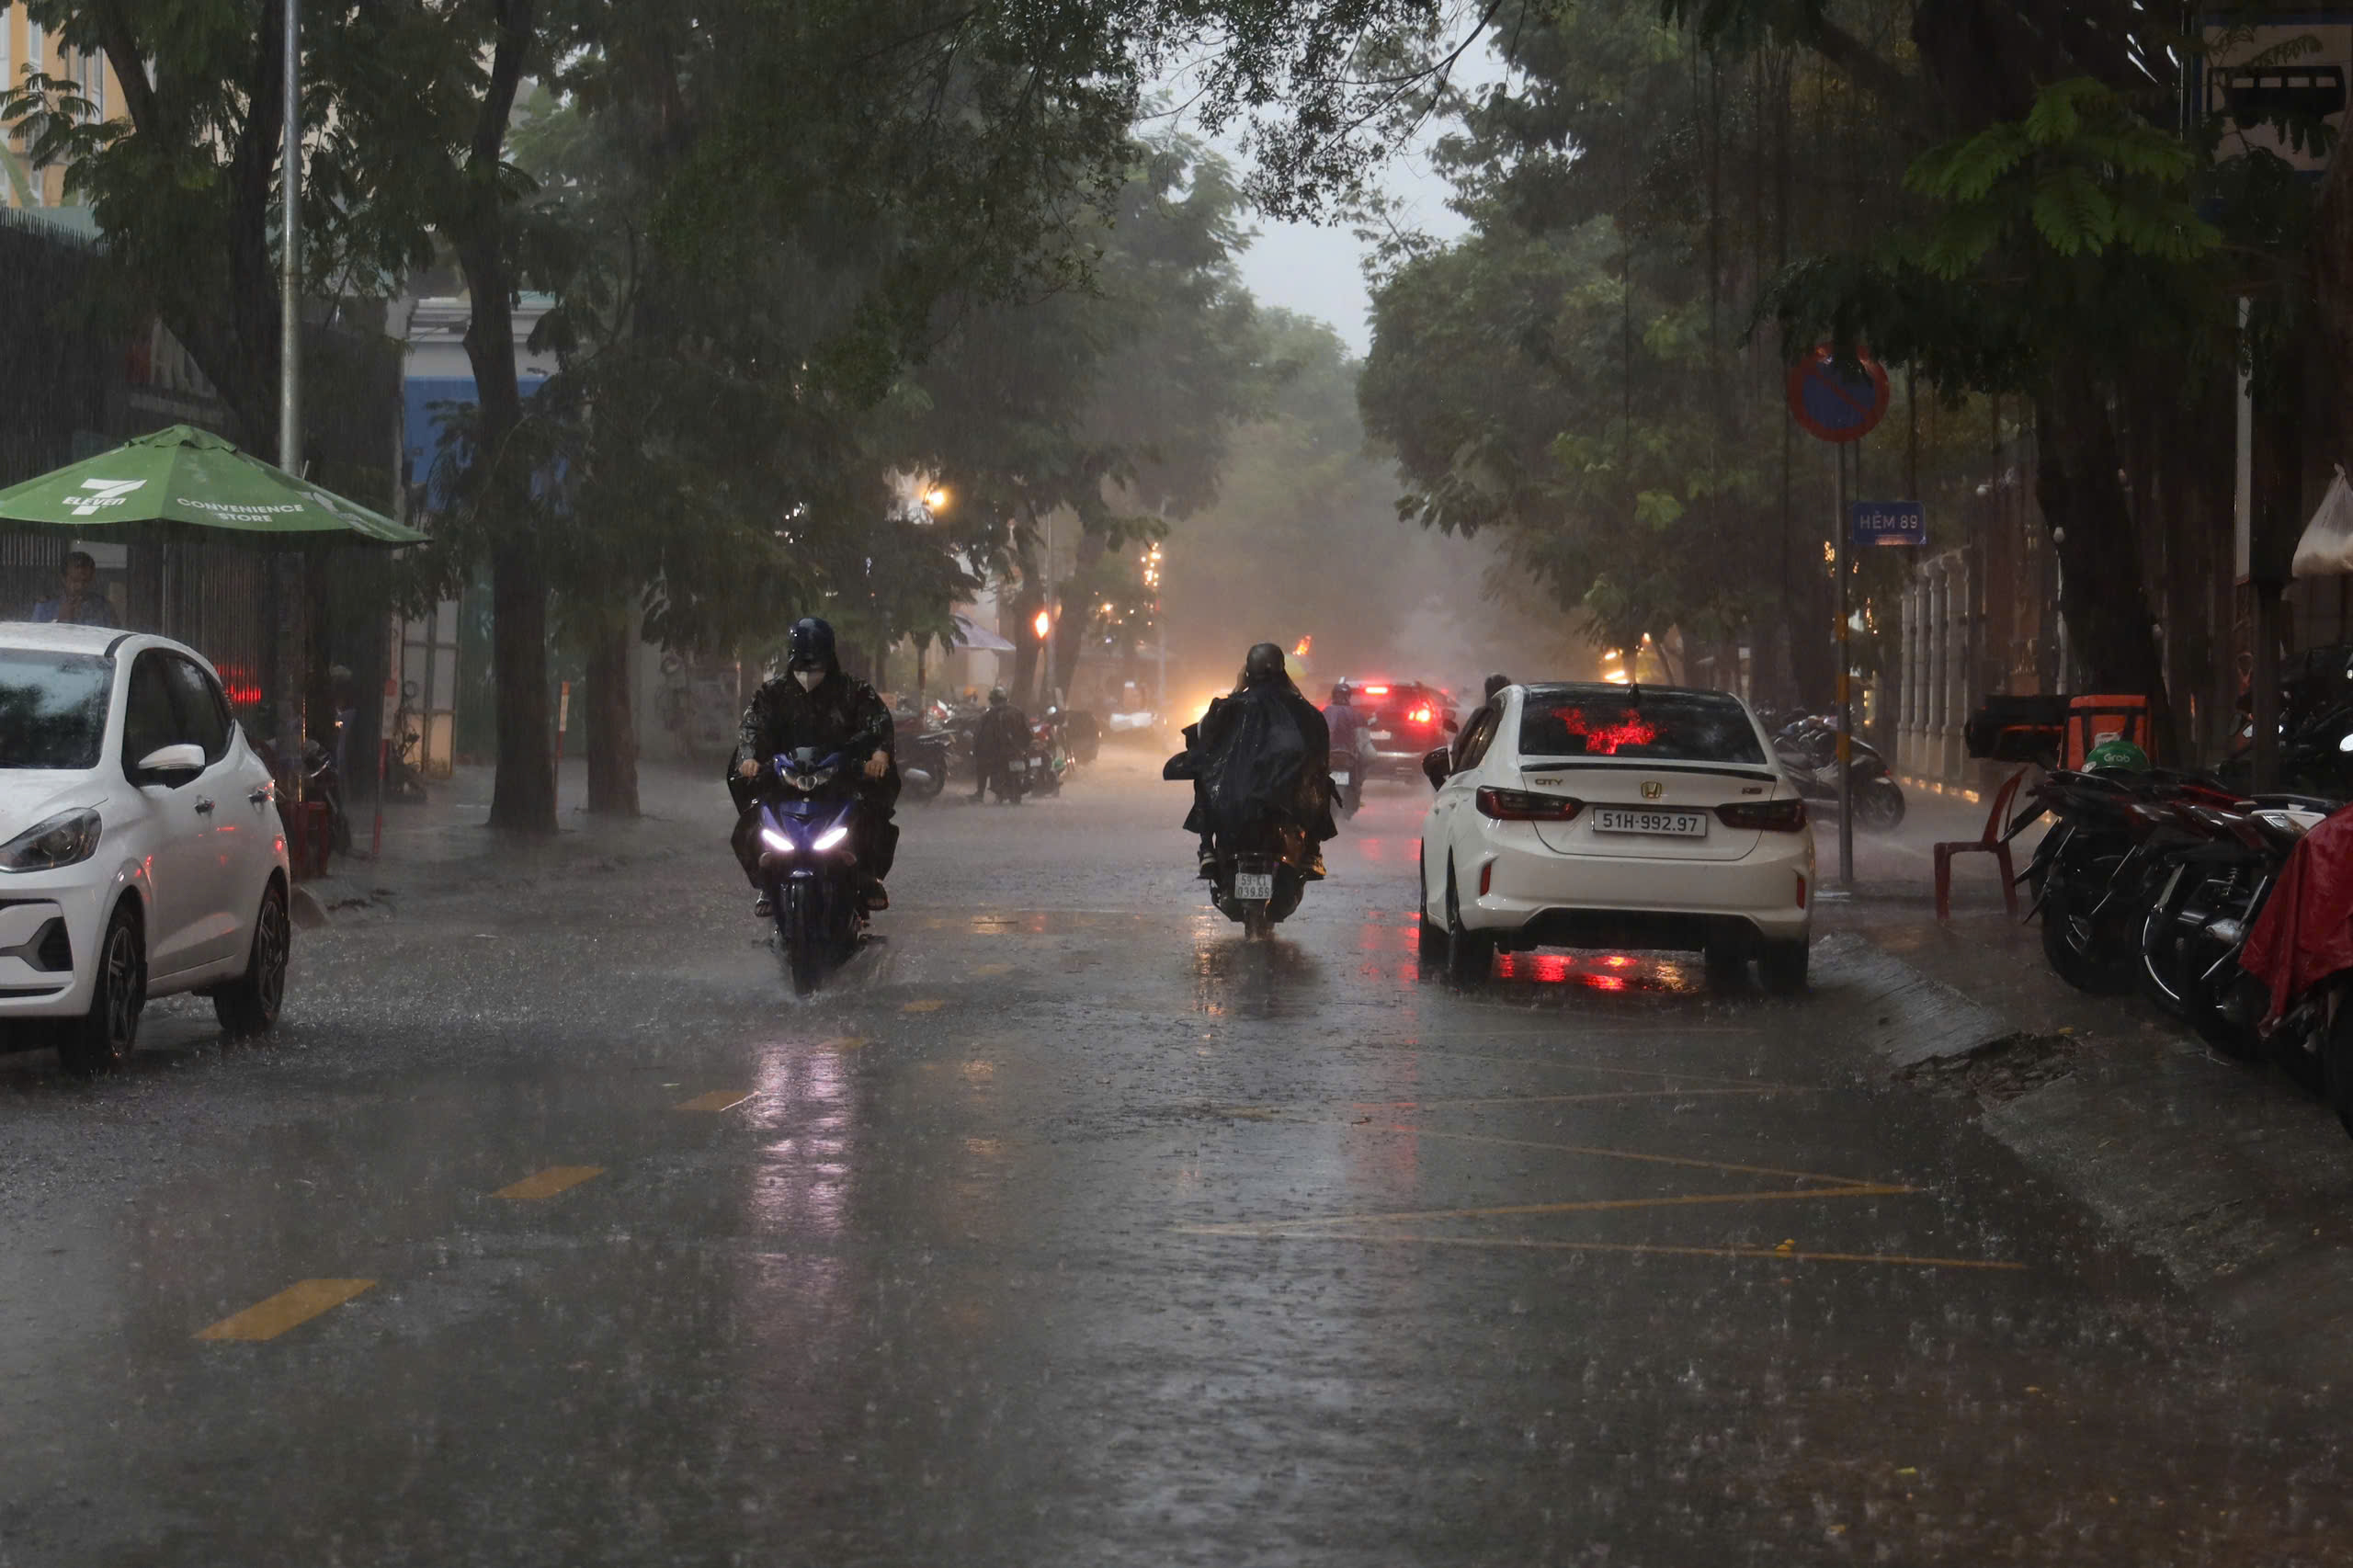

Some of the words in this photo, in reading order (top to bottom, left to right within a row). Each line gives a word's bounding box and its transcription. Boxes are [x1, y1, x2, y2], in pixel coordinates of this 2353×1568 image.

[72, 478, 147, 515] 7
[176, 497, 304, 513] CONVENIENCE
[218, 513, 272, 522] STORE
[1901, 515, 1918, 529] 89
[2103, 754, 2131, 763] Grab
[1603, 812, 1698, 832] 51H-992.97
